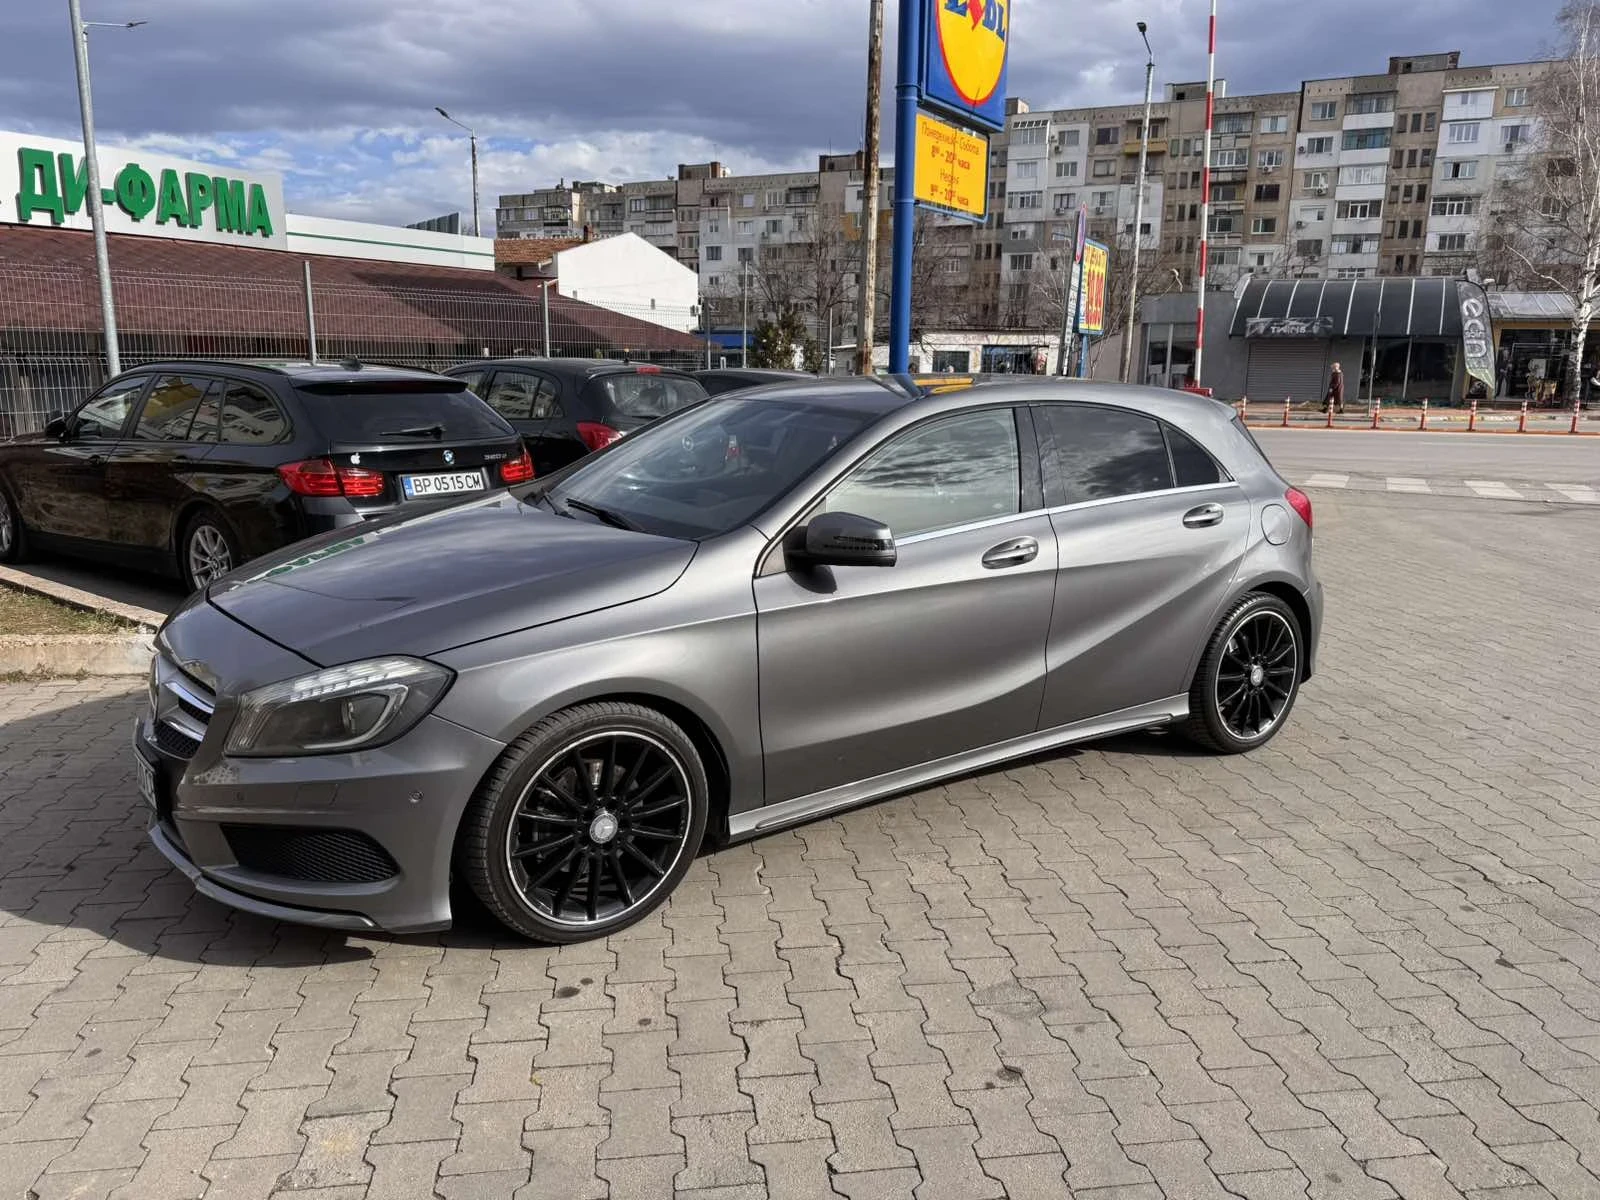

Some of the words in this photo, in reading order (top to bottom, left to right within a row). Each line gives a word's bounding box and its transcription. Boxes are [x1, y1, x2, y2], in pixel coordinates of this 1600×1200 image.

[16, 147, 274, 238] ДИ-ФАРМА
[413, 478, 431, 494] BP
[434, 475, 463, 491] 0515
[465, 474, 480, 489] CM
